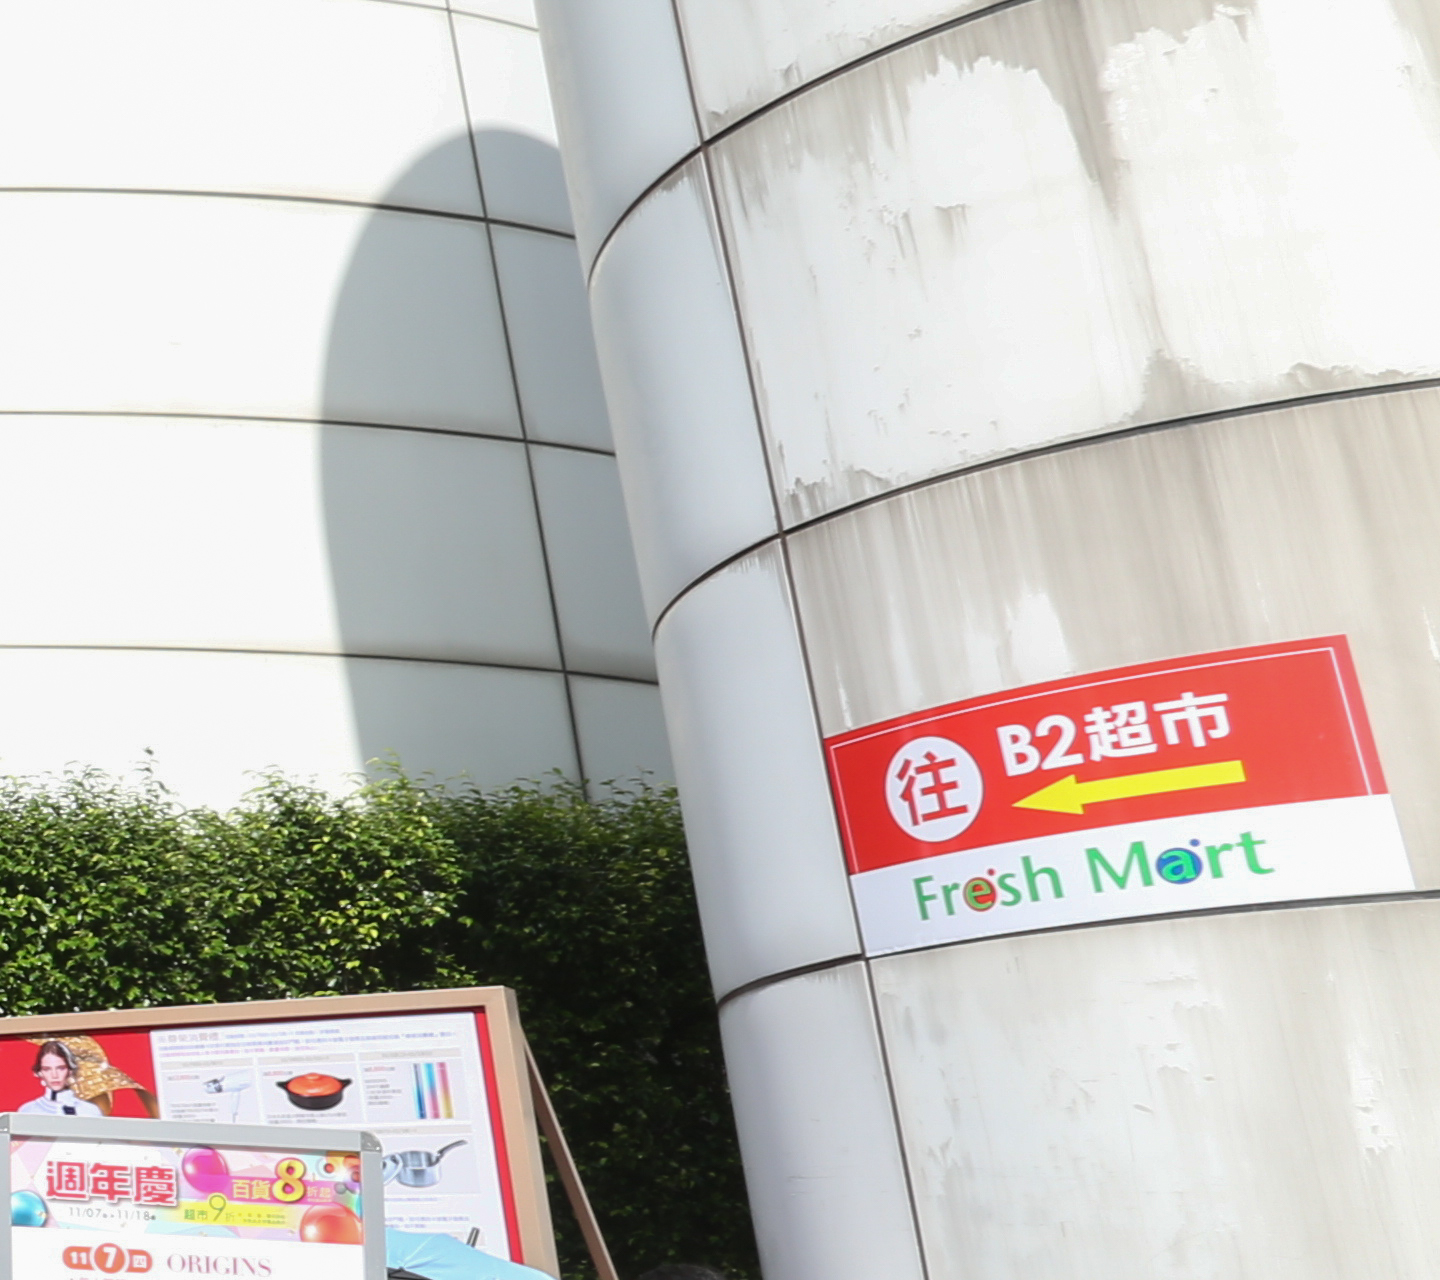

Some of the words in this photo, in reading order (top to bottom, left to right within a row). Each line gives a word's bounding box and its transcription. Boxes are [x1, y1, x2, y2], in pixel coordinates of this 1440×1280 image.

[896, 750, 969, 827] 往
[996, 691, 1232, 778] B2超市
[912, 854, 1064, 922] Fresh
[1085, 830, 1276, 894] Mart
[46, 1161, 178, 1206] 週年慶
[70, 1251, 88, 1265] 11
[103, 1247, 116, 1269] 7
[167, 1253, 272, 1277] ORIGINS
